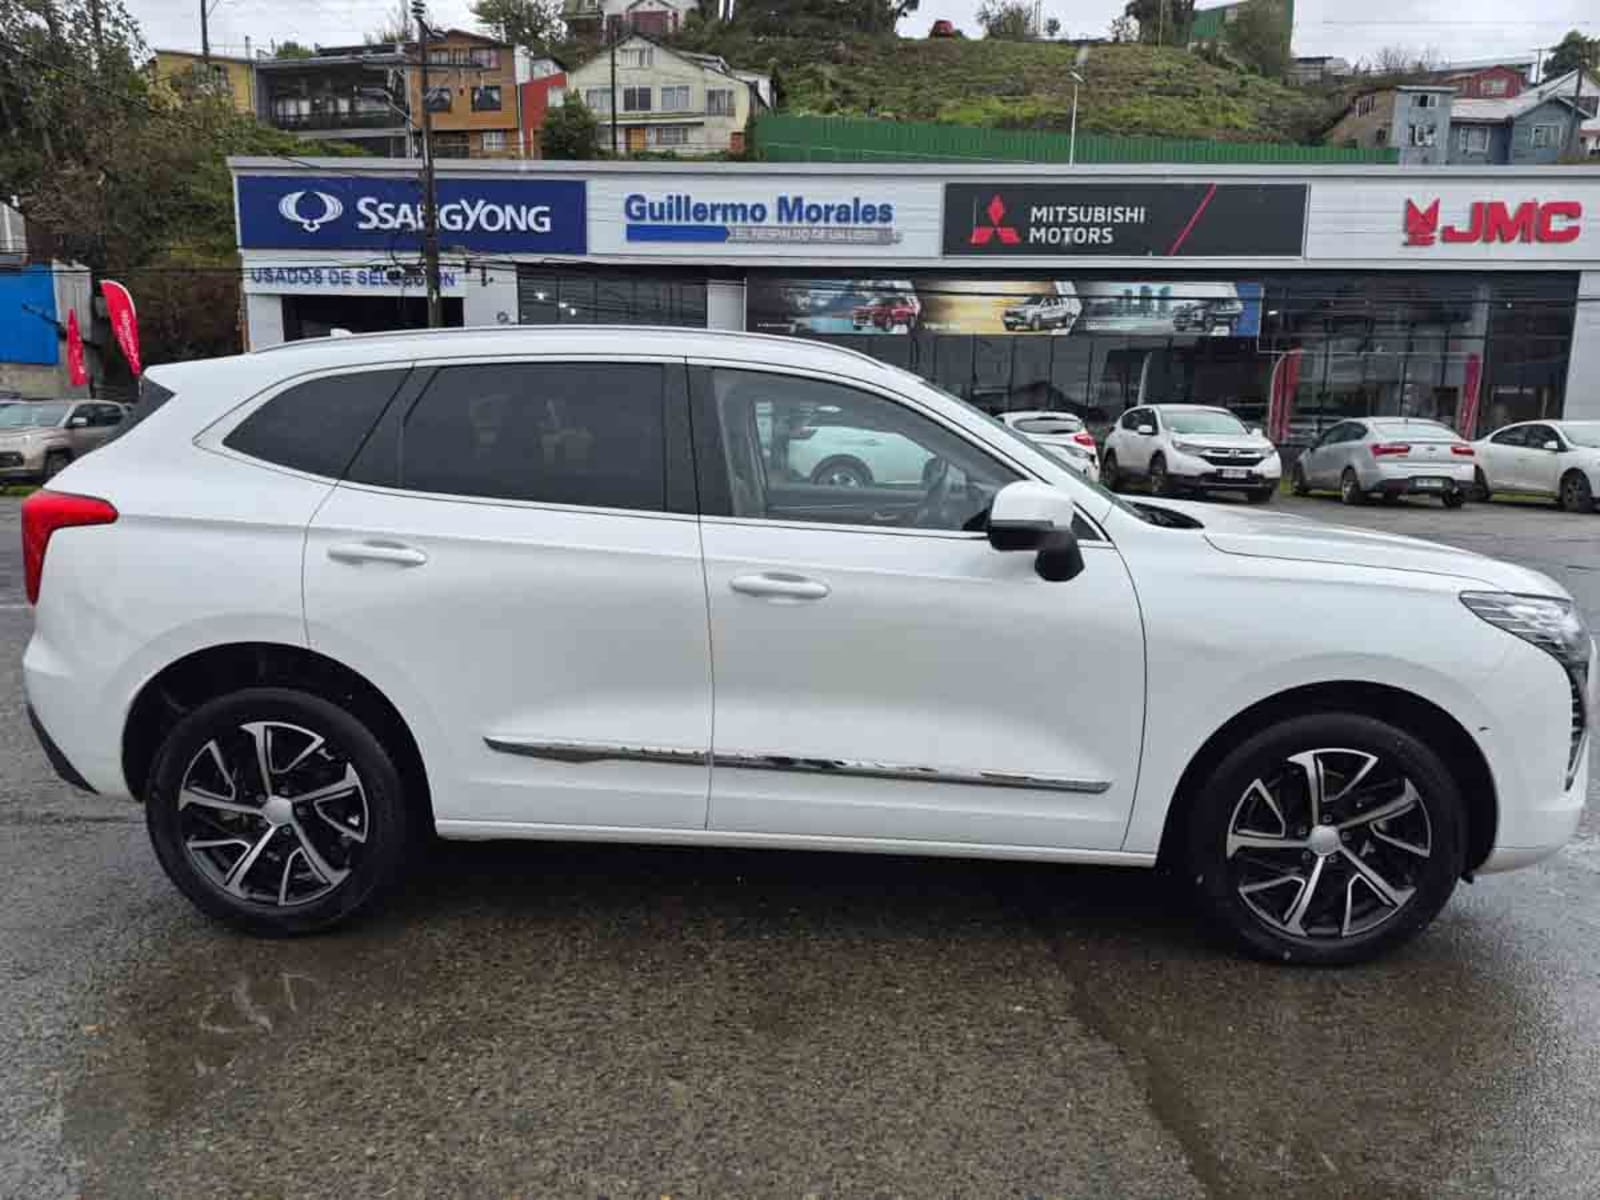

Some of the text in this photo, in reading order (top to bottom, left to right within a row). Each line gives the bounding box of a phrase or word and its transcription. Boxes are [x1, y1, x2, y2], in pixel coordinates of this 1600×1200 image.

[624, 194, 894, 225] Guillermo Morales
[1031, 206, 1146, 223] MITSUBISHI
[1441, 201, 1582, 243] JMC
[1029, 227, 1113, 244] MOTORS
[251, 267, 323, 285] USADOS
[328, 269, 350, 285] DE
